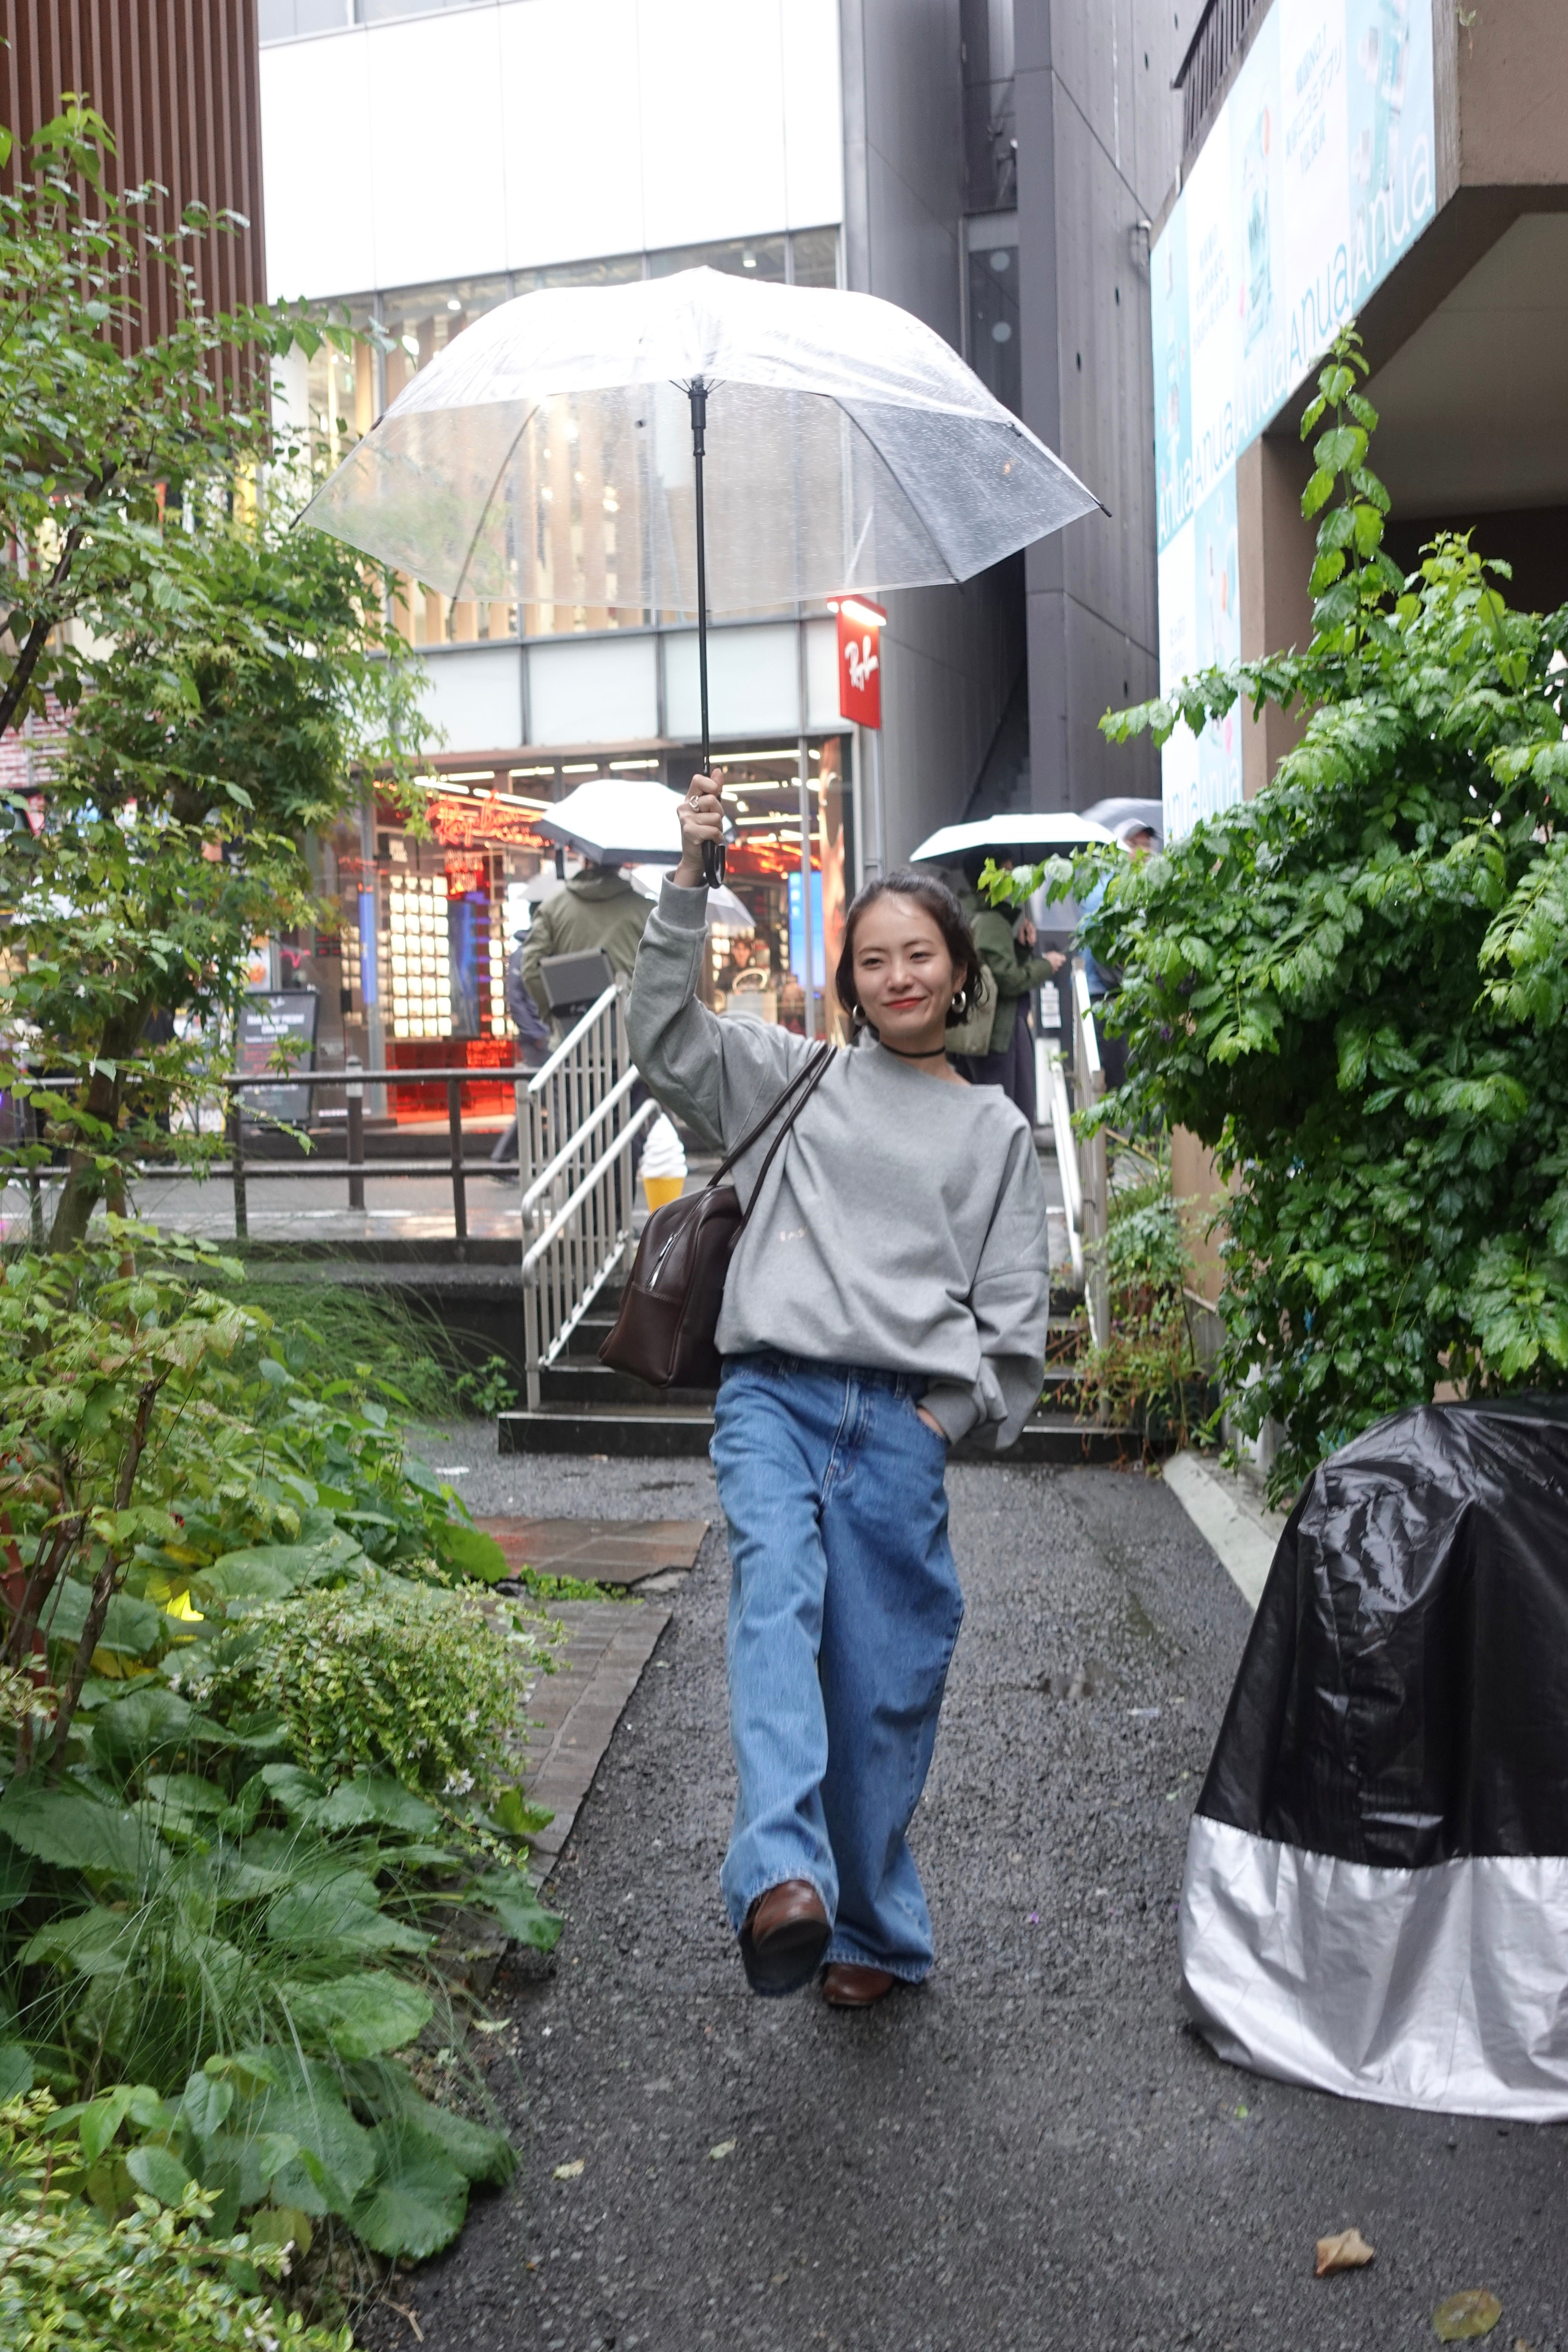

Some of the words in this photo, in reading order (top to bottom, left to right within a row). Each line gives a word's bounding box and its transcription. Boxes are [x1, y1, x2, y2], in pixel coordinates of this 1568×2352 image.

[1353, 133, 1433, 300] Anua
[1289, 242, 1350, 380] Anua
[1232, 329, 1286, 450] Anua
[1158, 456, 1194, 547] Anua
[1195, 401, 1234, 503] Anua
